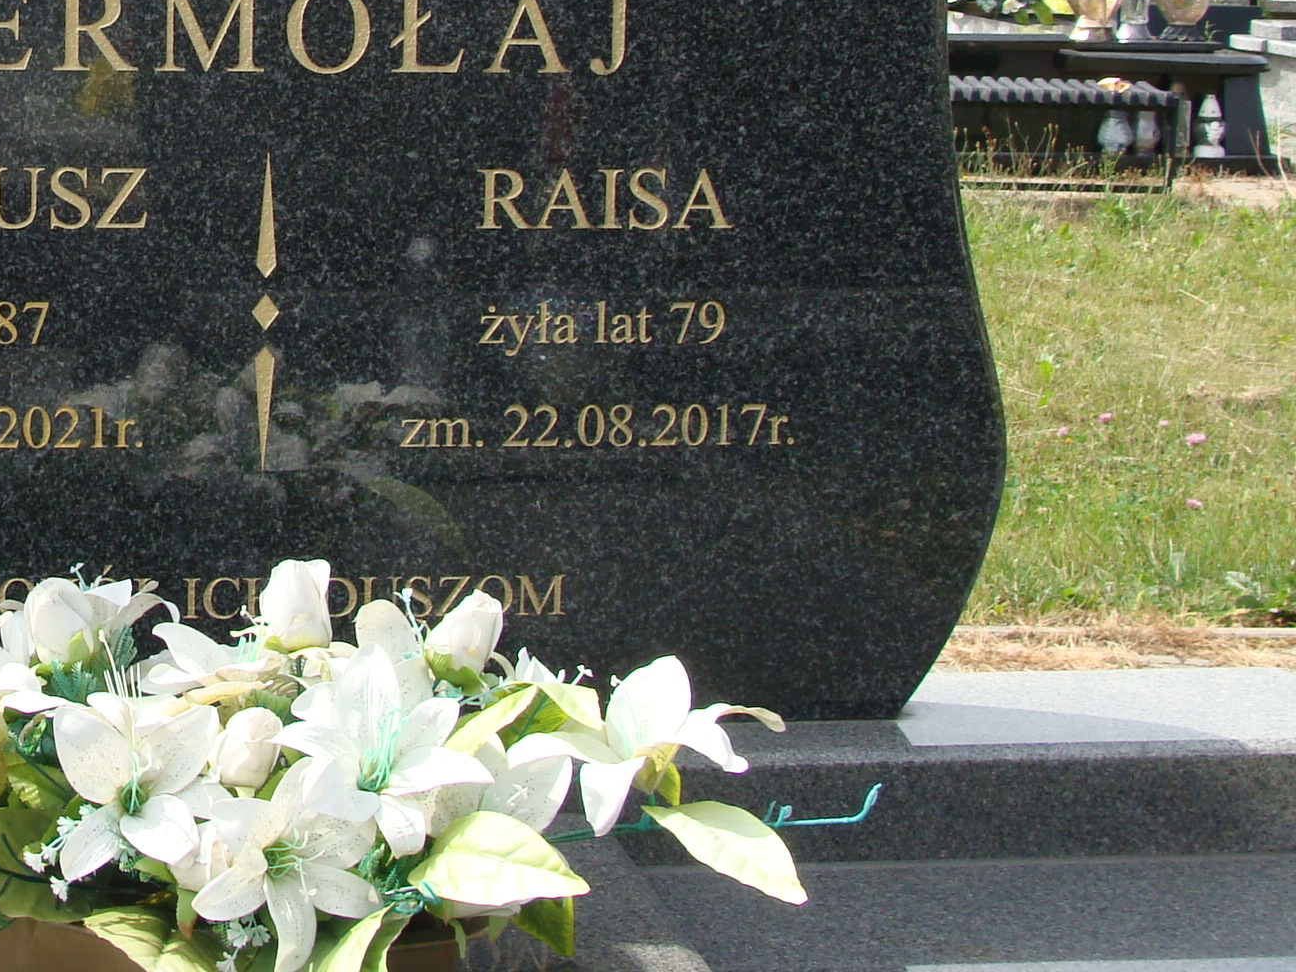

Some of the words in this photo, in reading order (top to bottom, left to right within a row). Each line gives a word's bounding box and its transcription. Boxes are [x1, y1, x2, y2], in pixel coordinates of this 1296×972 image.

[475, 167, 733, 230] RAISA
[478, 301, 578, 357] żyła
[597, 300, 653, 345] lat
[669, 301, 726, 345] 79
[400, 415, 485, 450] zm.
[503, 402, 796, 450] 22.08.2017r.
